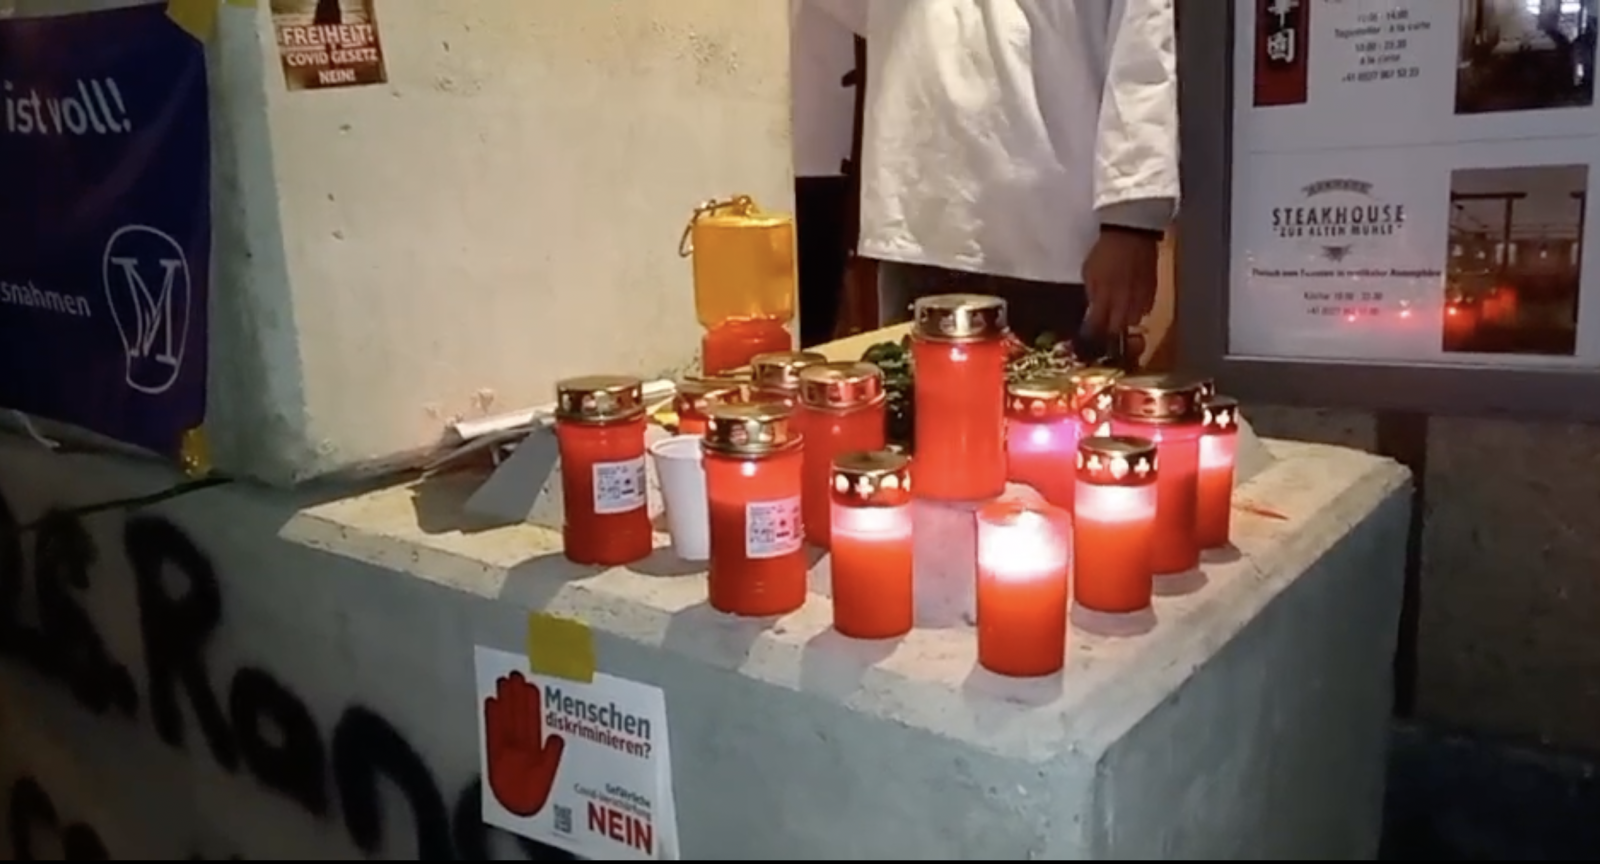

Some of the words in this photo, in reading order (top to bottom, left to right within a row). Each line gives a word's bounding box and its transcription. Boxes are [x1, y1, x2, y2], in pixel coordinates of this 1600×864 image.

[281, 24, 374, 46] FREIHEIT!
[286, 52, 328, 66] COVID
[330, 48, 379, 64] GESETZ
[318, 68, 357, 85] NEIN!
[5, 80, 47, 134] ist
[48, 77, 132, 134] voll!
[1272, 204, 1405, 226] STEAKHOUSE
[0, 280, 91, 318] snahmen
[545, 685, 651, 740] Menschen
[545, 713, 652, 760] diskriminieren?
[588, 800, 652, 856] NEIN
